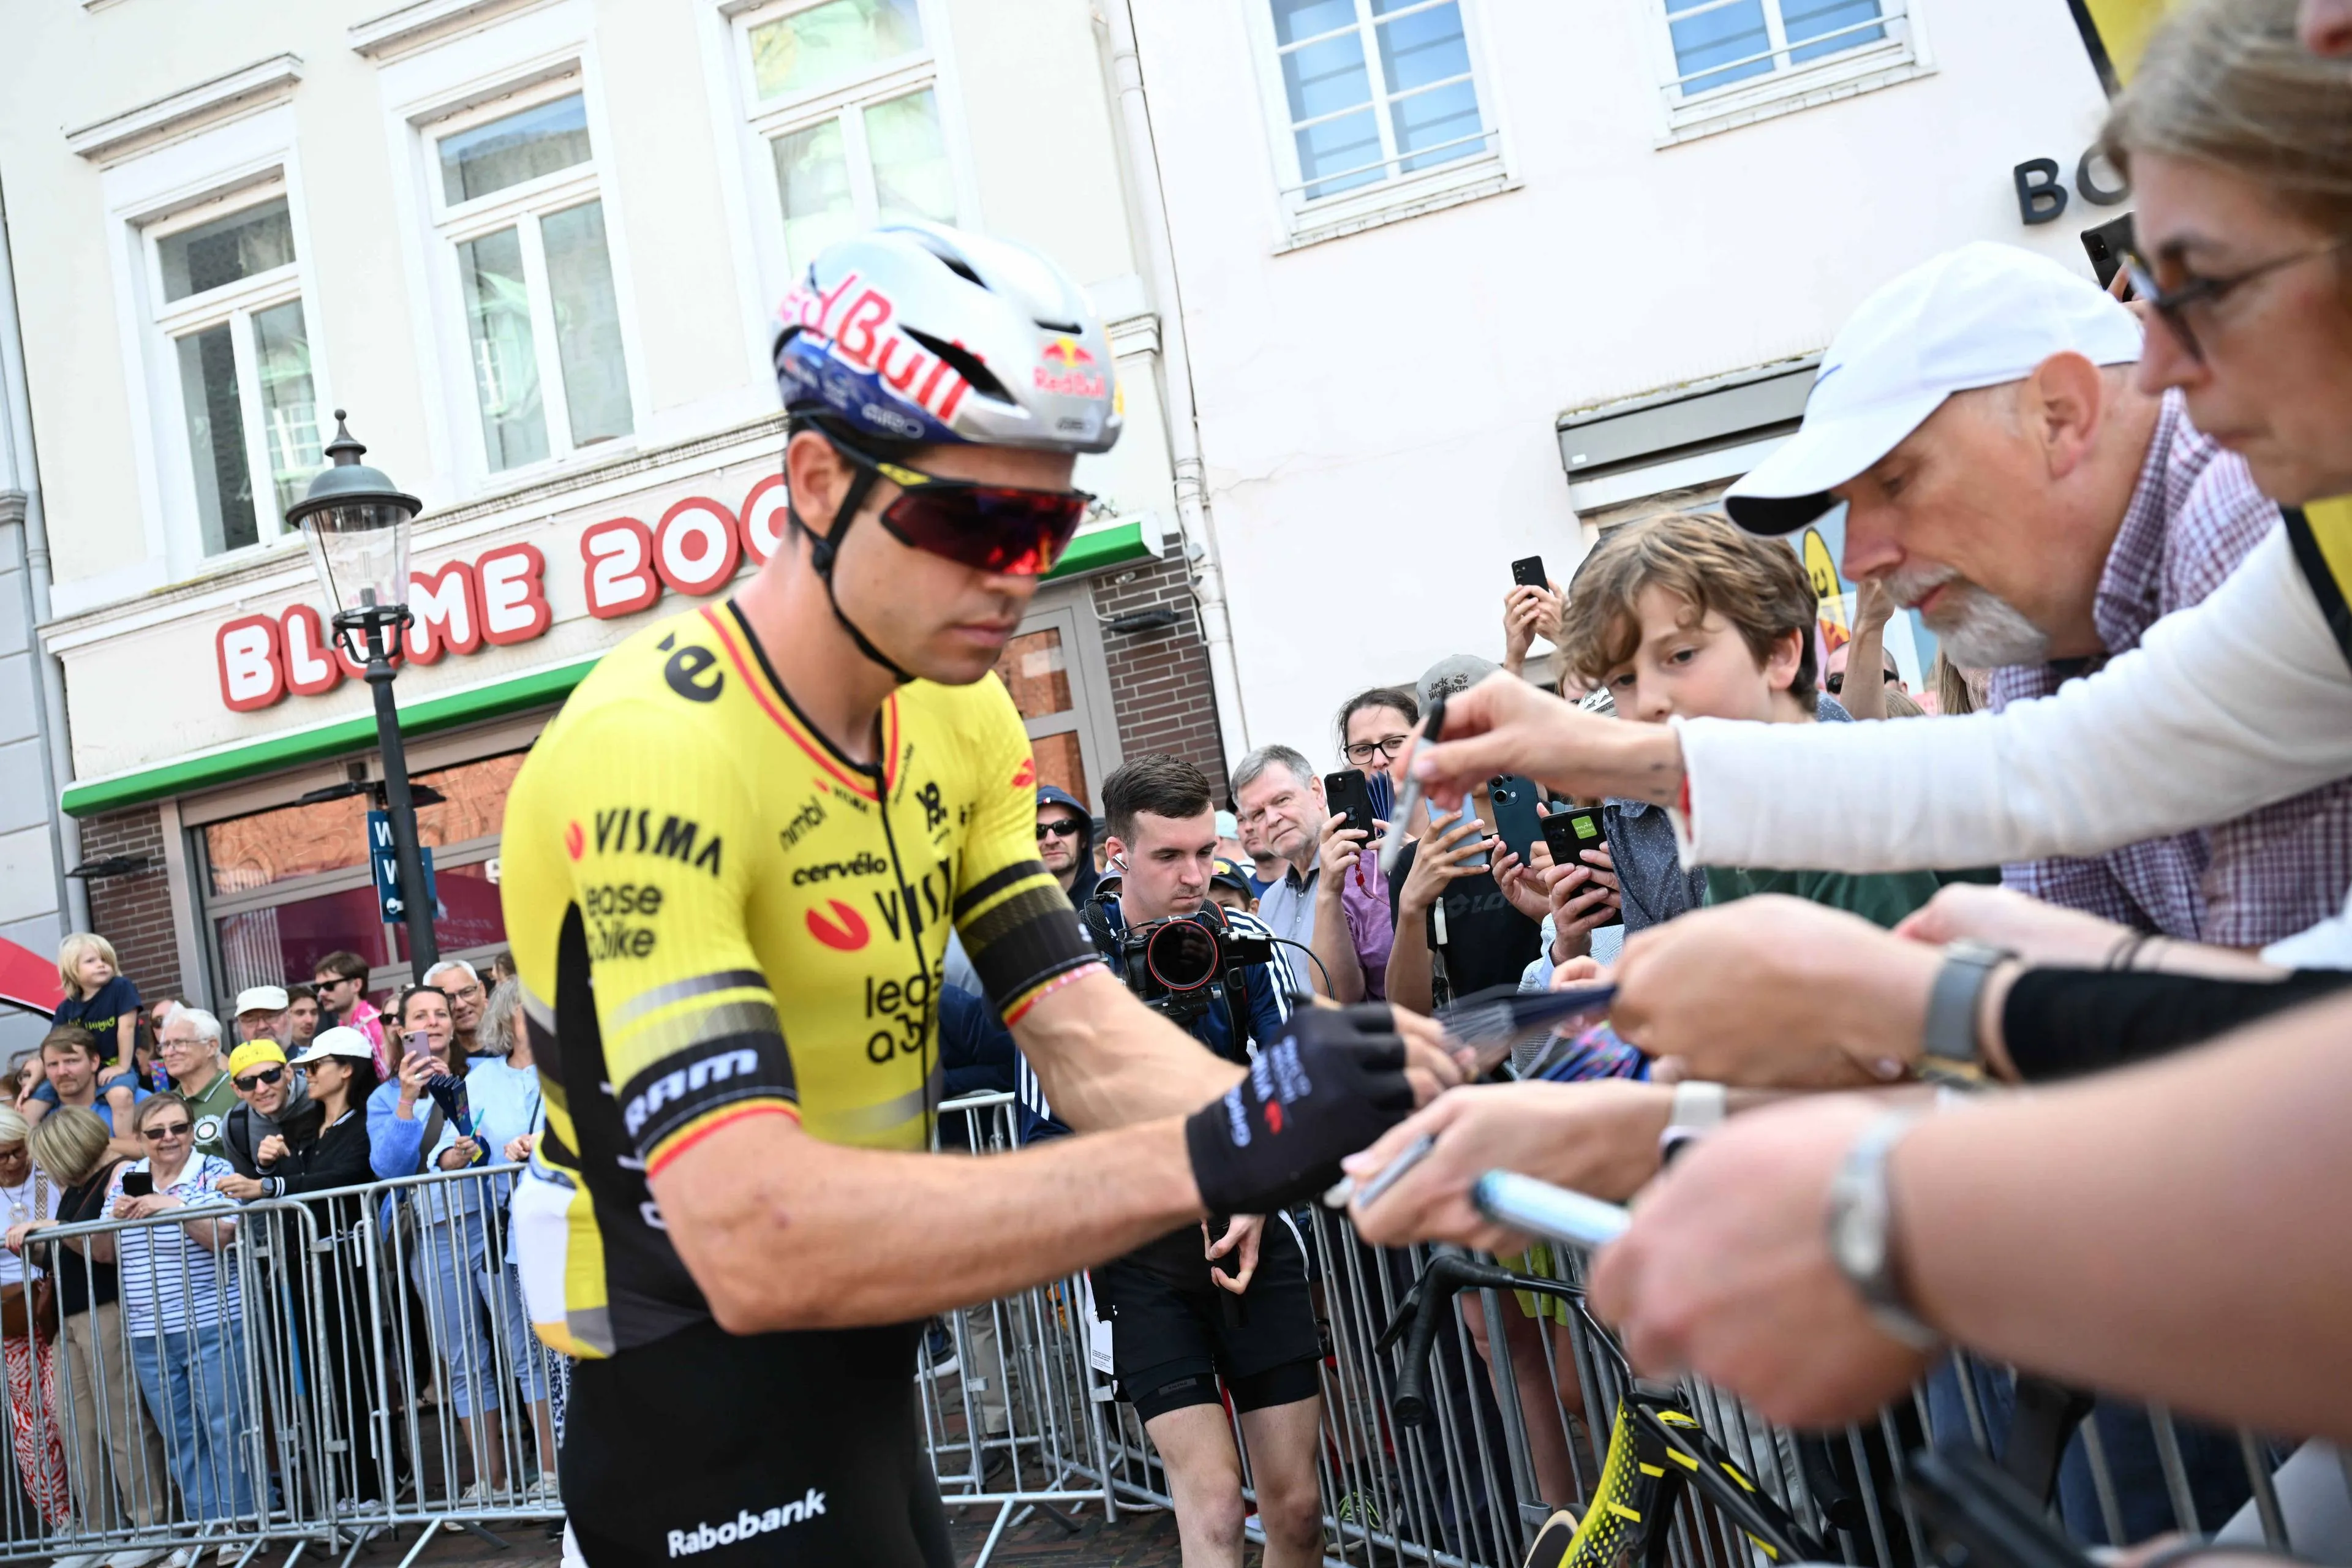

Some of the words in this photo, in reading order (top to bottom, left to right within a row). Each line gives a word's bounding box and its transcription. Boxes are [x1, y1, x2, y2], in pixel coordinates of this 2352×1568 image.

[836, 288, 986, 421] Bull
[1428, 677, 1449, 693] Jack
[595, 807, 722, 878] VISMA
[667, 1487, 827, 1559] Rabobank
